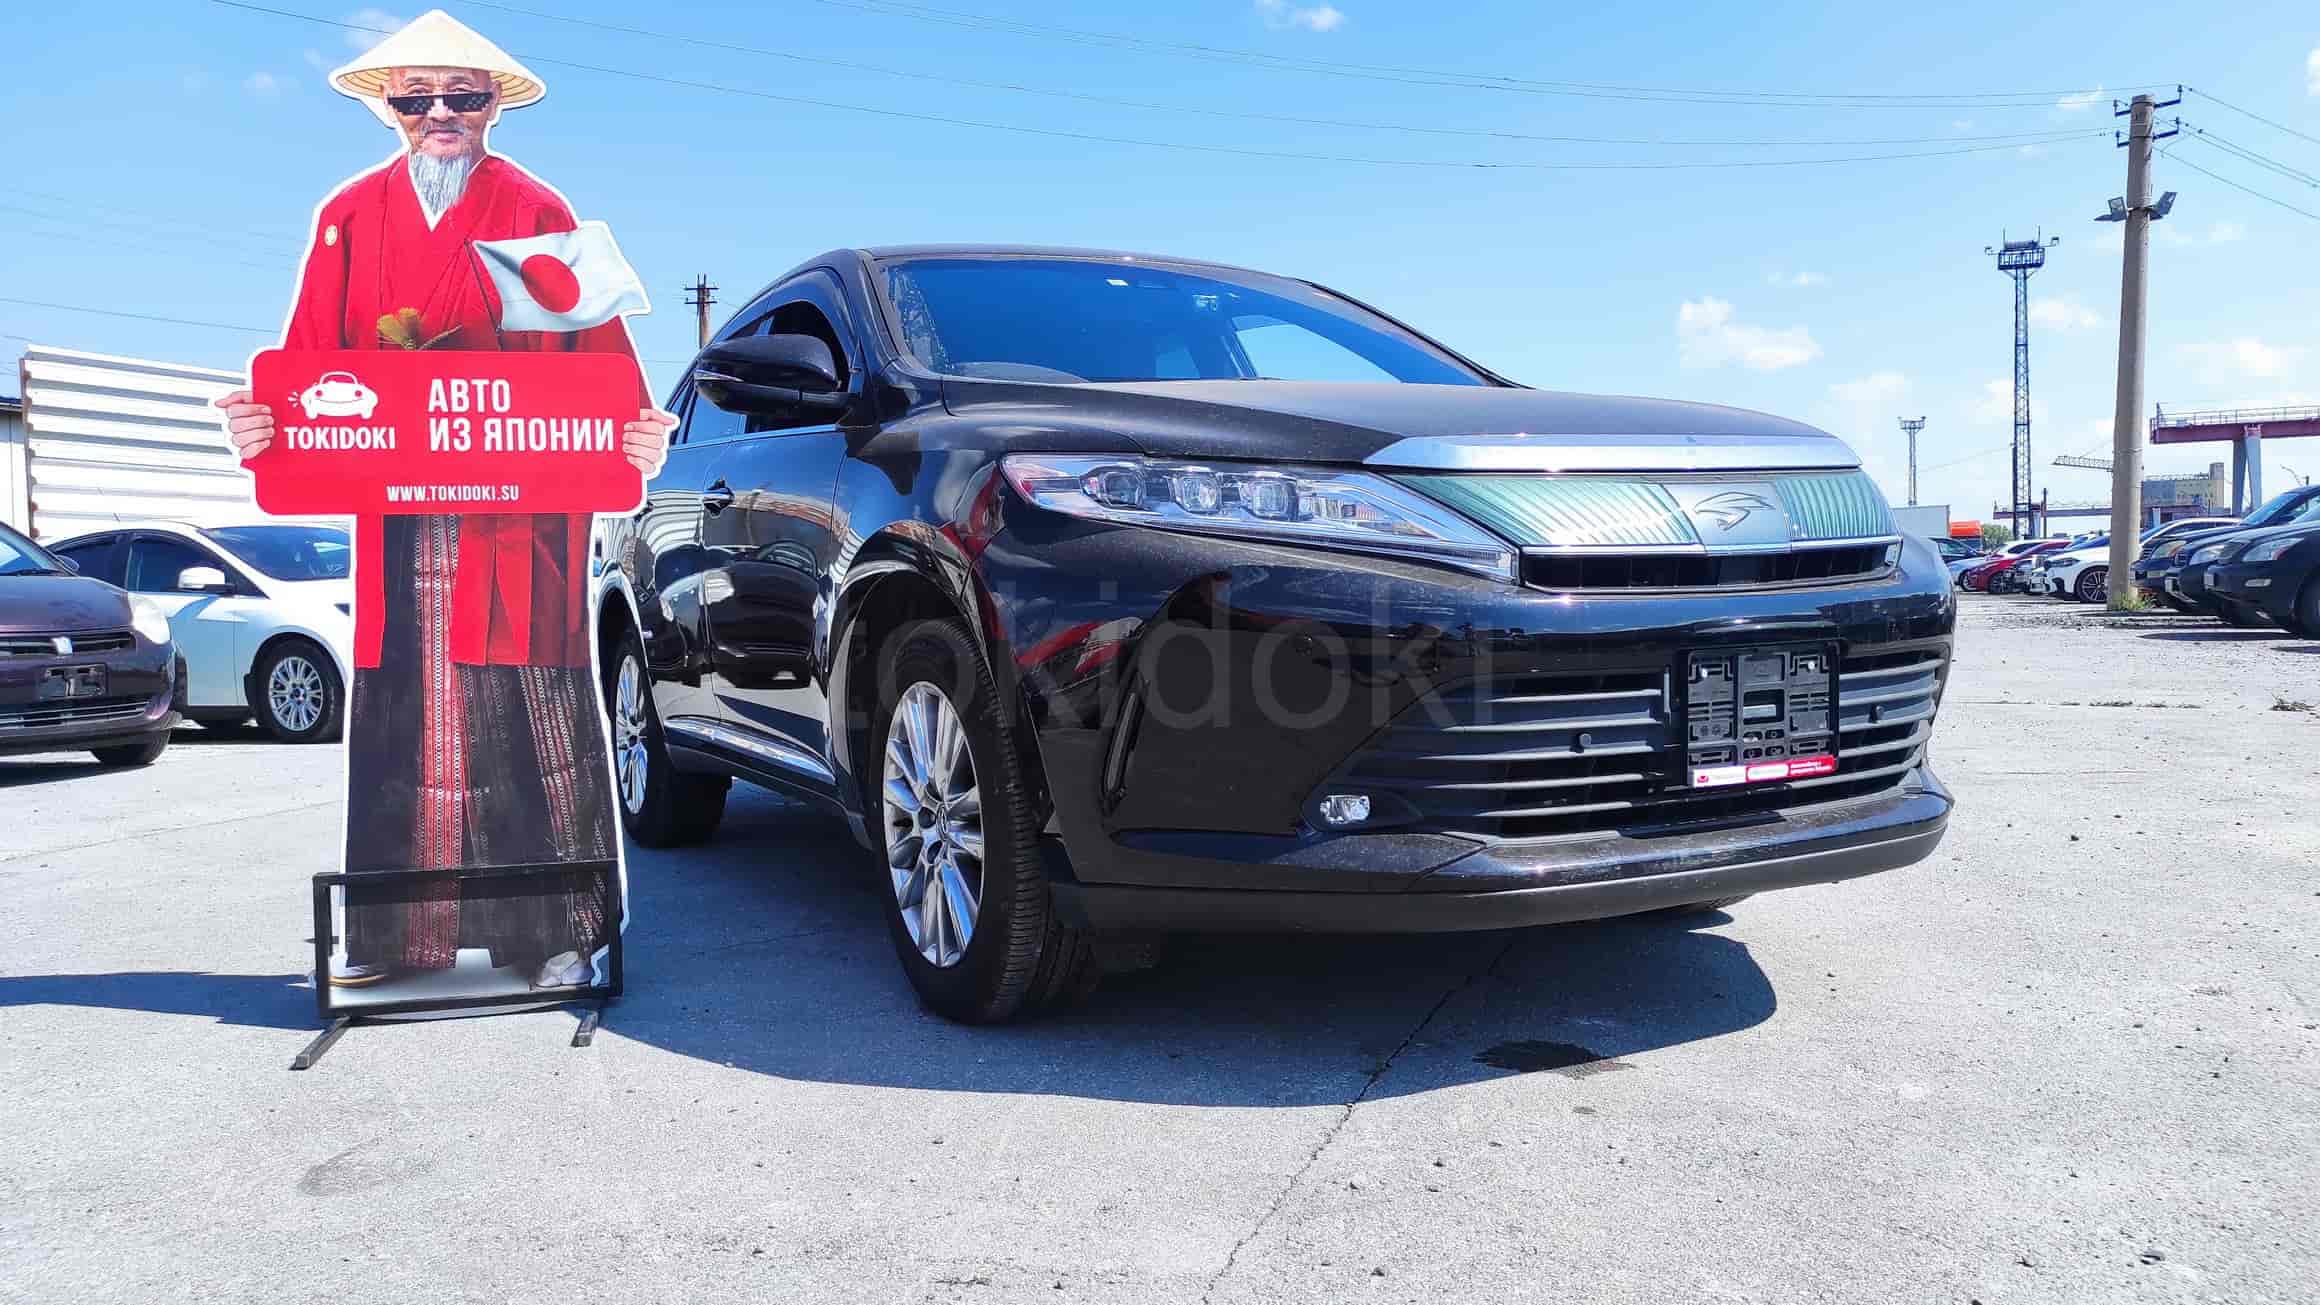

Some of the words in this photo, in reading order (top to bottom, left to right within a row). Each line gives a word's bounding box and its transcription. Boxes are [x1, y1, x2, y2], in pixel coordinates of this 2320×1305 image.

[428, 379, 511, 413] АВТО
[284, 426, 396, 450] TOKIDOKI
[429, 418, 472, 451] ИЗ
[484, 418, 615, 451] ЯПОНИИ
[386, 485, 520, 503] WWW.TOKIDOKI.SU
